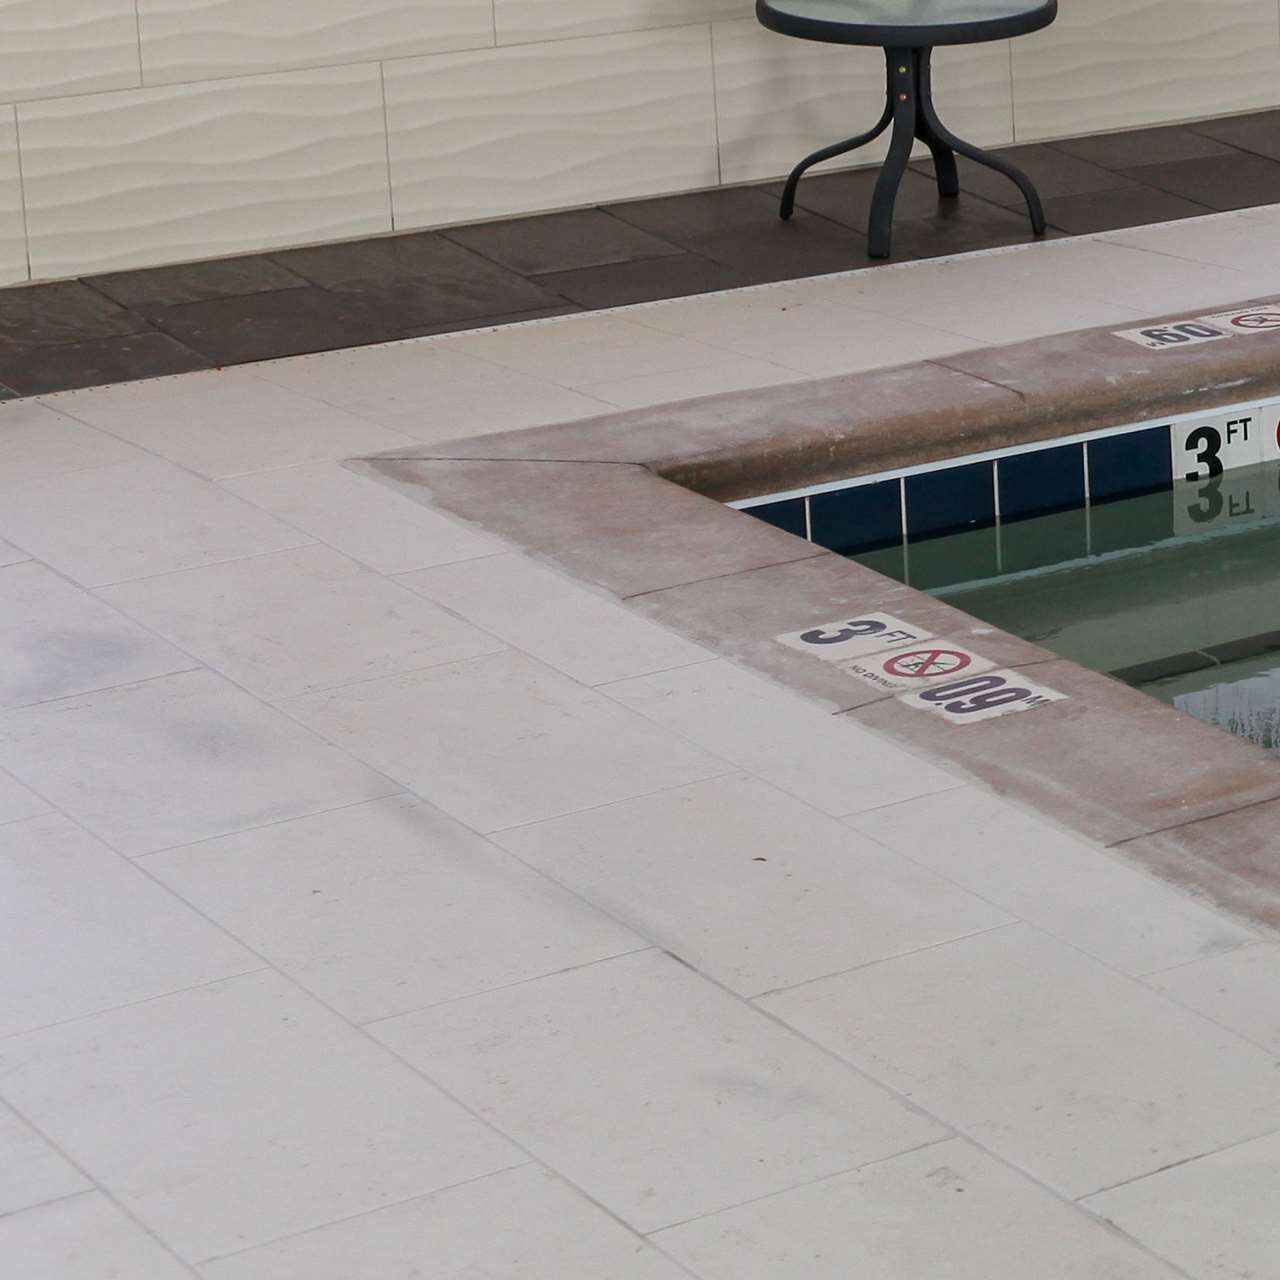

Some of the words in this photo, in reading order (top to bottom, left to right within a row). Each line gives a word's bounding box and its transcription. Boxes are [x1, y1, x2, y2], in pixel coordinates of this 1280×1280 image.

[1185, 426, 1224, 482] 3
[1226, 417, 1252, 444] FT
[800, 620, 888, 644] 3
[874, 630, 917, 644] FT
